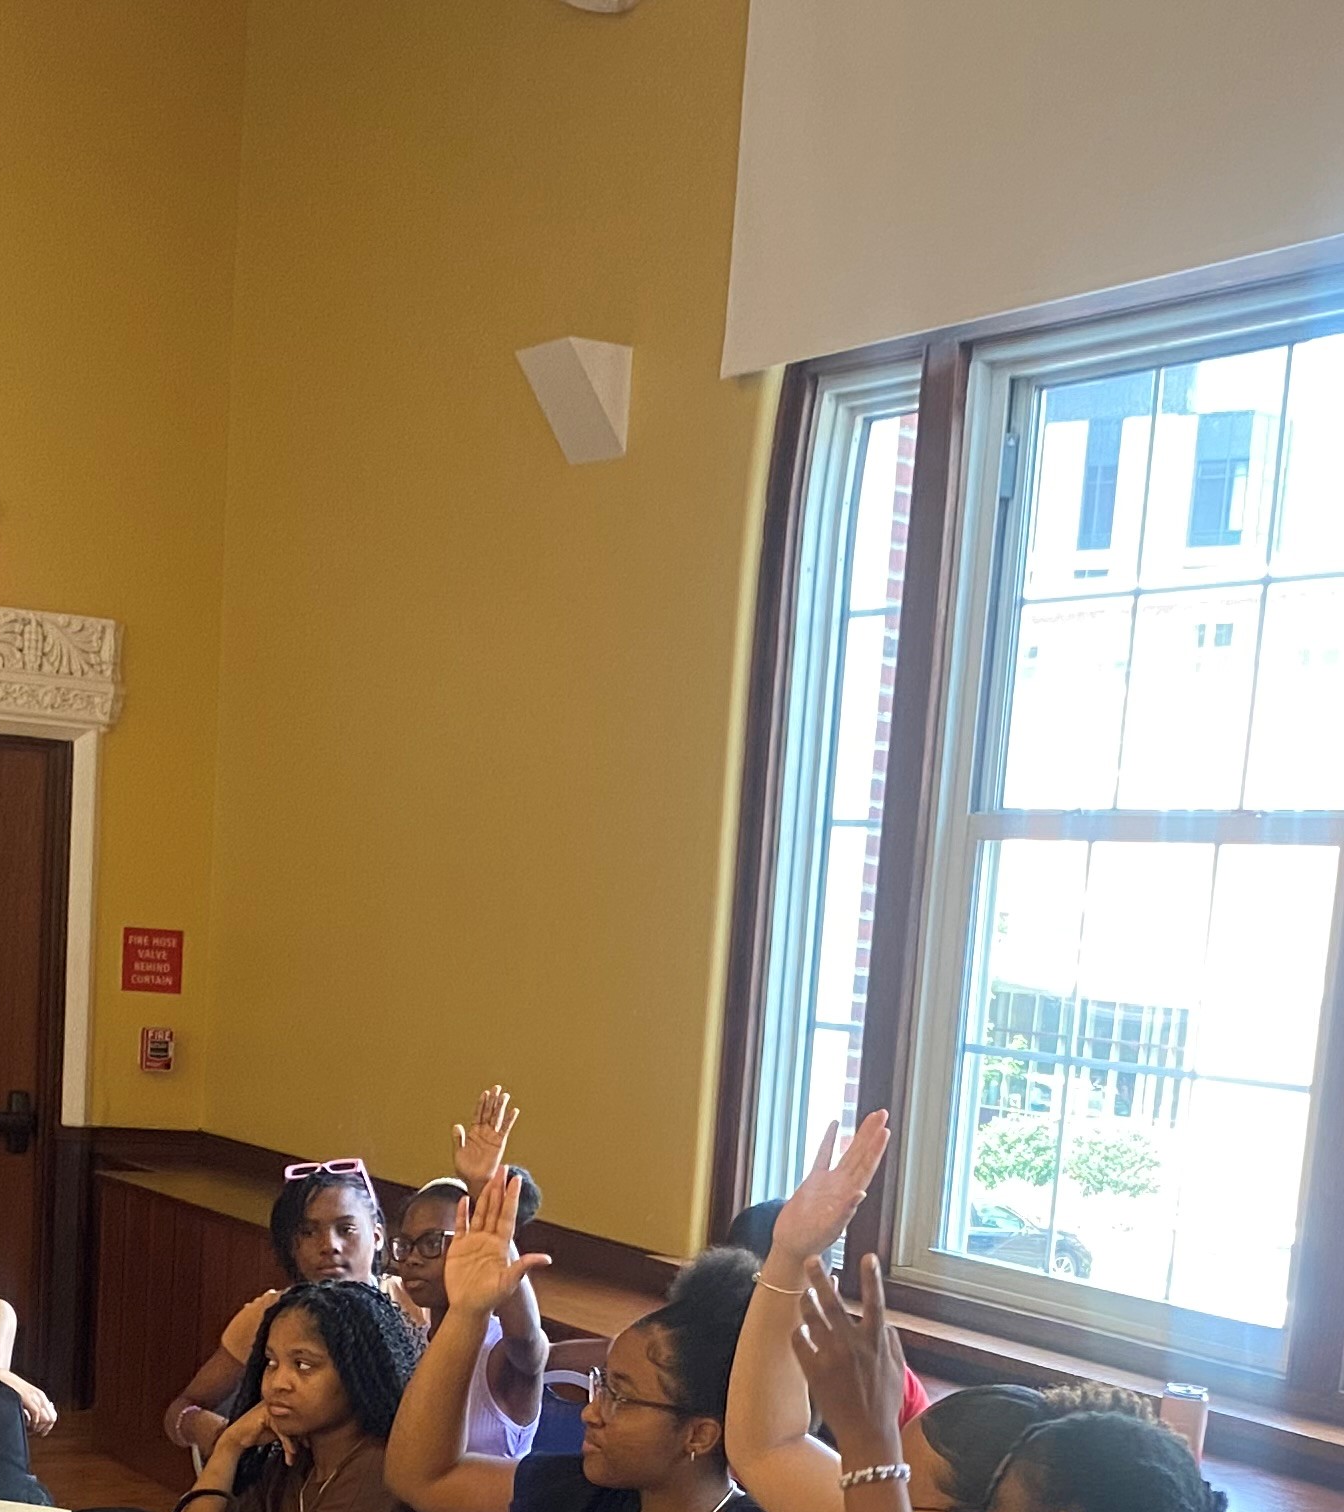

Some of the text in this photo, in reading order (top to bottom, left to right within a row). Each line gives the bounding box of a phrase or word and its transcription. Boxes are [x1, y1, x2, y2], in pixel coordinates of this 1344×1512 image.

[128, 935, 149, 946] FIRE
[137, 949, 168, 960] VALVE
[134, 961, 171, 973] BEHIND
[131, 974, 173, 986] CURTAIN
